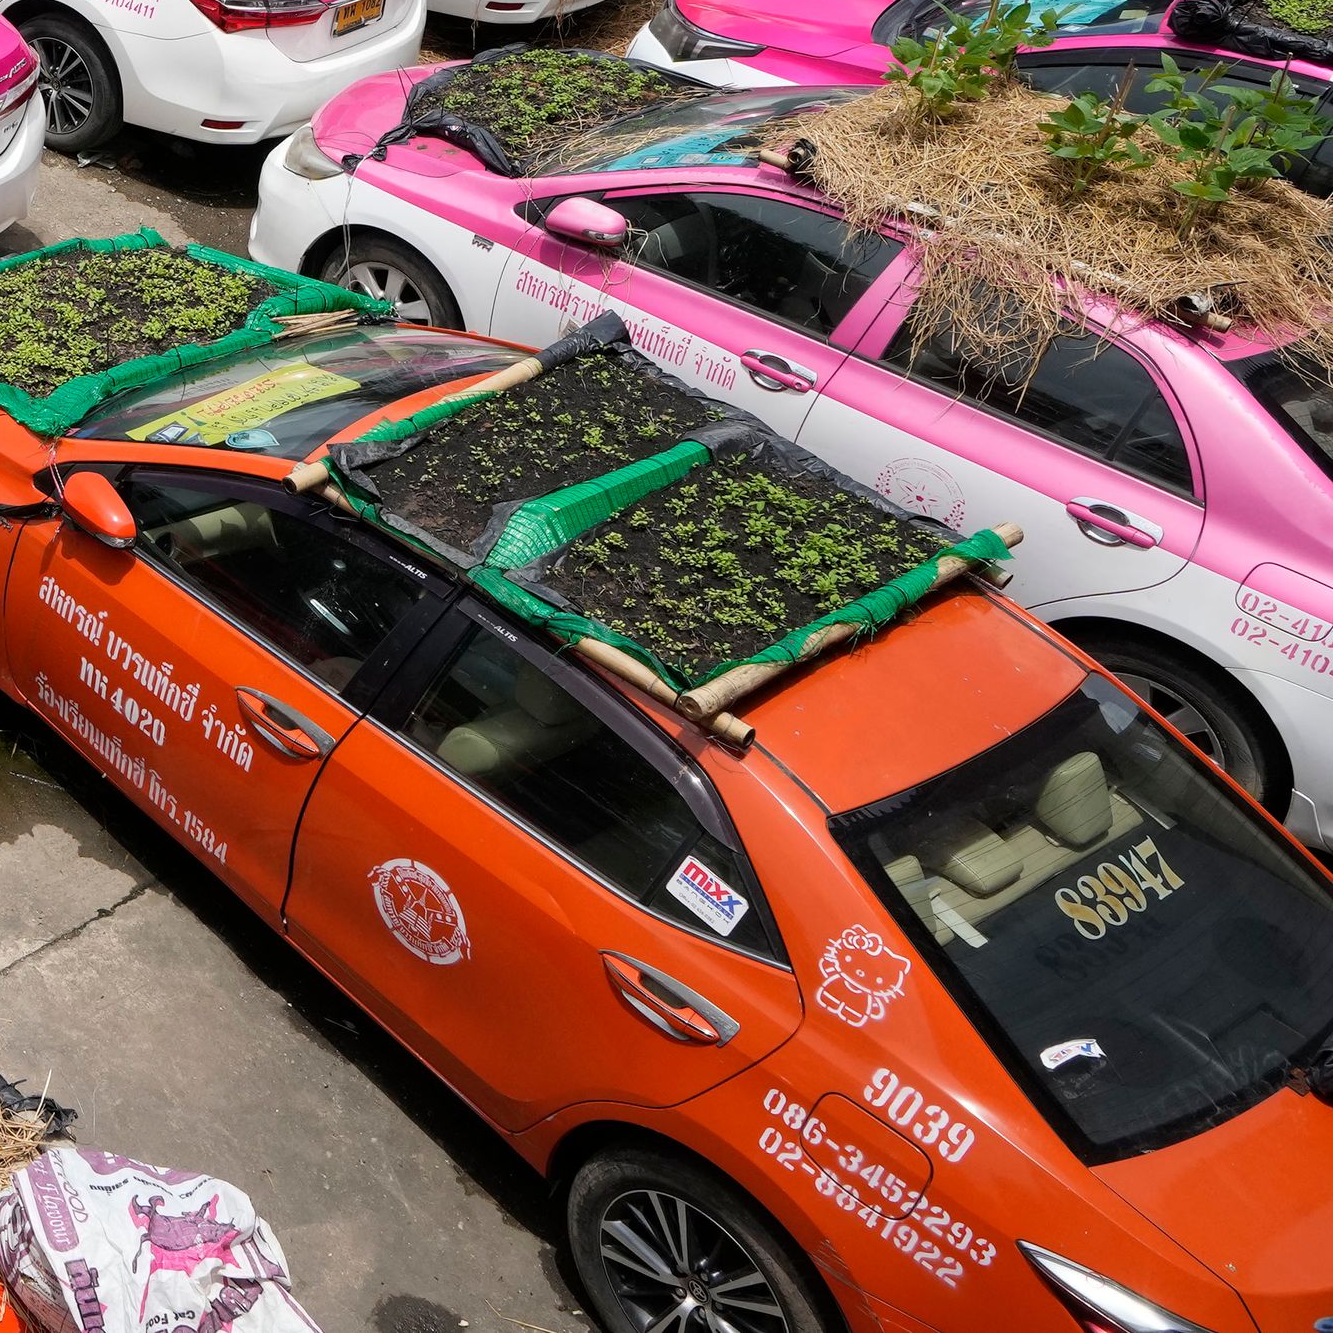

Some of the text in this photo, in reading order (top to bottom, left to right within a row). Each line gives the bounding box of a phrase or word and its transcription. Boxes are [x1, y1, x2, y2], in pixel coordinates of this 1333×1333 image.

[693, 345, 736, 391] จำกัด
[38, 575, 254, 773] สหกรณ์ บวรแท็กซี่ จำกัด
[79, 656, 167, 748] ทห 4020
[1054, 834, 1186, 941] 83947
[863, 1067, 977, 1163] 9039
[36, 1181, 70, 1246] Flavour
[757, 1126, 965, 1288] 02-8841922
[762, 1087, 998, 1267] 086-3452293
